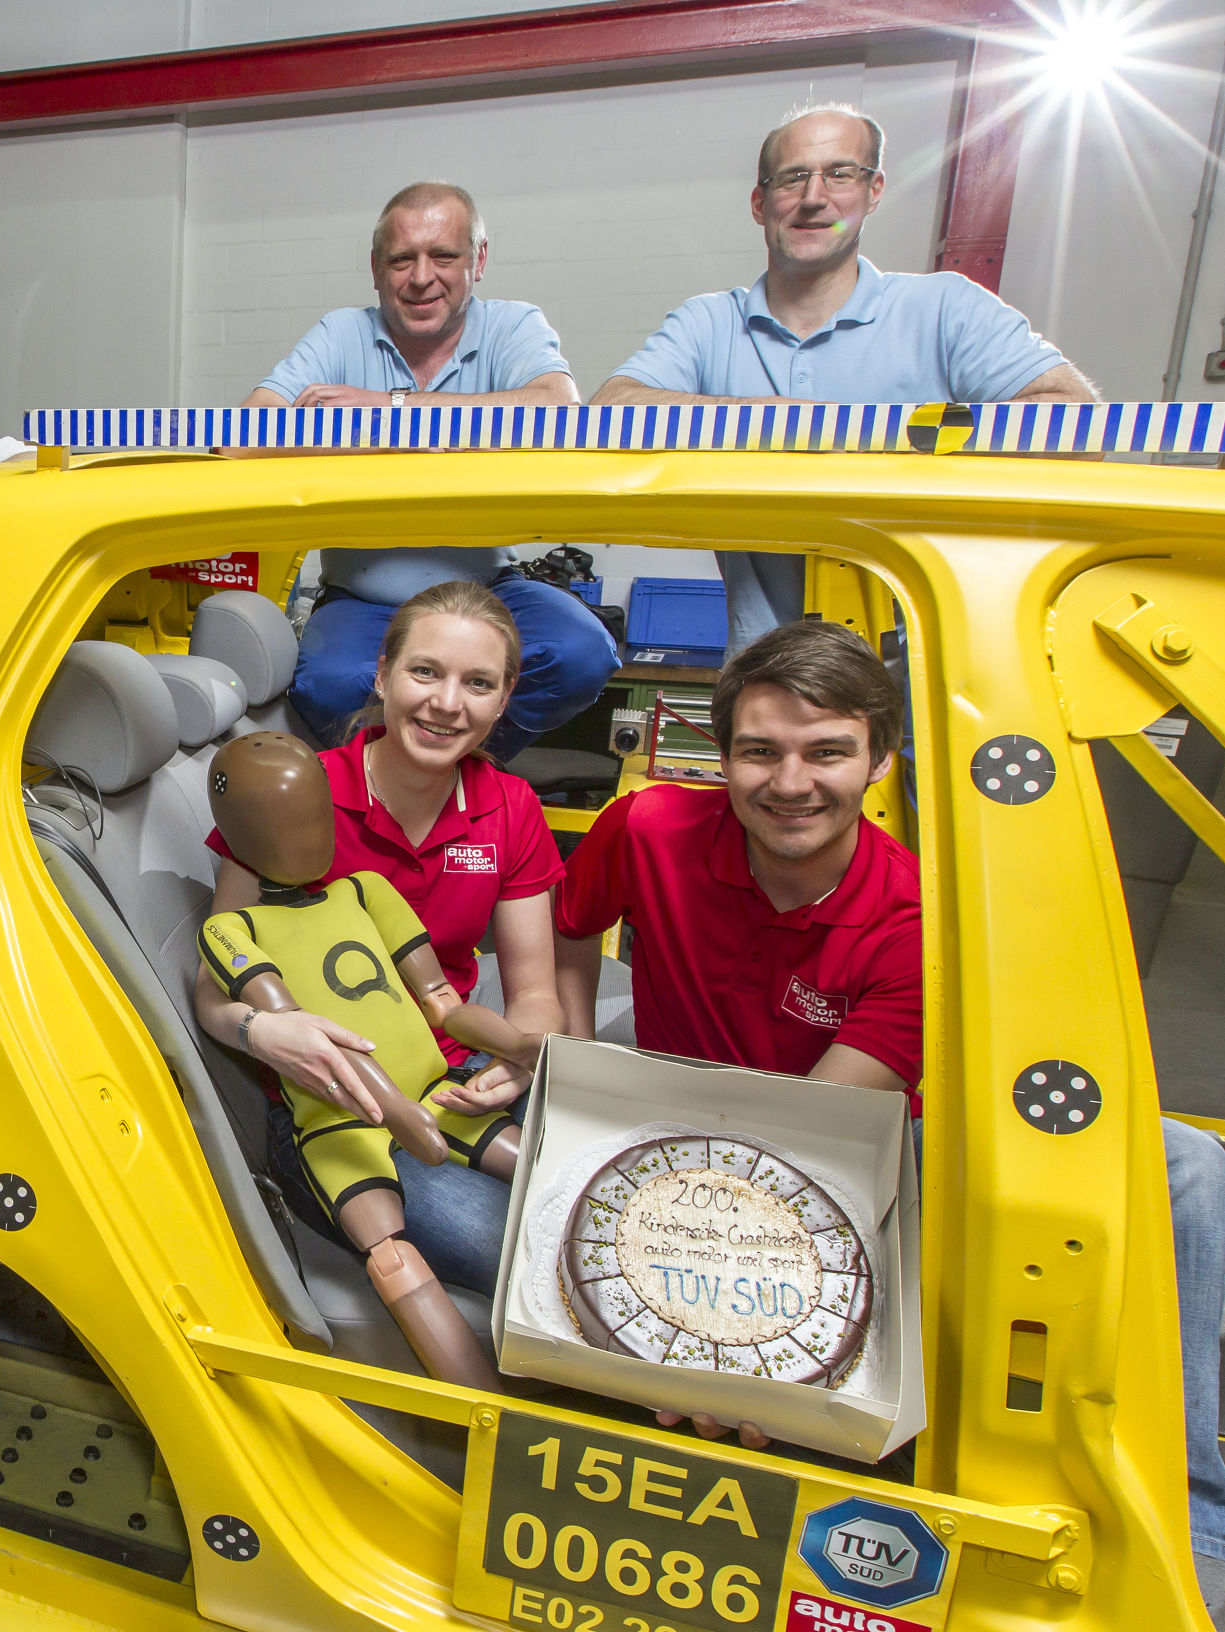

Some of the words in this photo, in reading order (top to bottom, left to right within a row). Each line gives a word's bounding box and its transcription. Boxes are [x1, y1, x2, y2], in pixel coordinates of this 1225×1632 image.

[197, 571, 254, 587] sport
[447, 847, 483, 858] auto
[454, 857, 491, 865] motor
[467, 863, 495, 871] sport
[322, 940, 402, 1004] Q
[791, 981, 828, 1008] auto
[795, 996, 838, 1018] motor
[671, 1179, 739, 1212] 200.
[649, 1263, 721, 1310] TÜV
[731, 1276, 804, 1319] SÜD
[527, 1436, 759, 1539] 15EA
[837, 1531, 911, 1567] TÜV
[503, 1512, 762, 1623] 00686
[847, 1563, 884, 1581] SÜD
[512, 1585, 605, 1632] E02
[794, 1598, 896, 1632] auto
